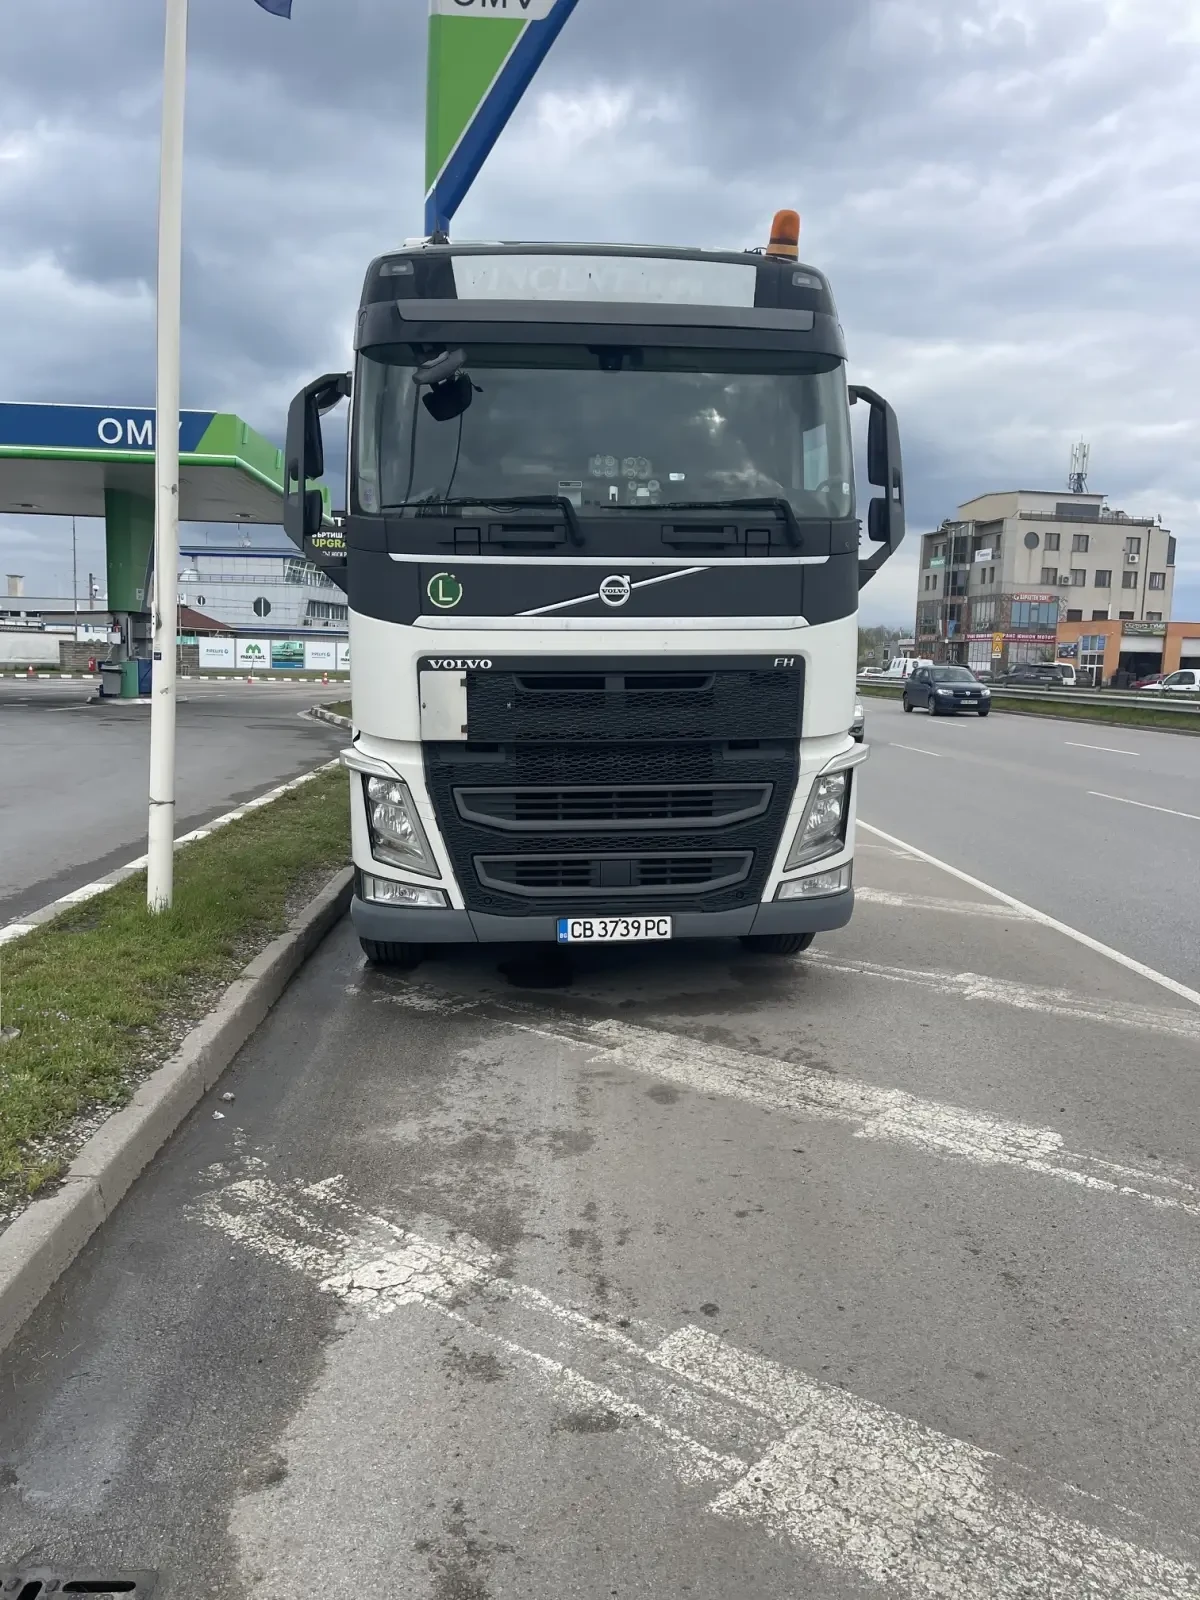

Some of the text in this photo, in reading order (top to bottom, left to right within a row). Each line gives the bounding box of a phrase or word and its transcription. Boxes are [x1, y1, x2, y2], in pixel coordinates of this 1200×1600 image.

[98, 418, 183, 445] OM
[438, 579, 453, 601] L
[428, 659, 493, 669] VOLVO
[773, 657, 795, 667] FH
[571, 918, 668, 939] CB 3739 PC
